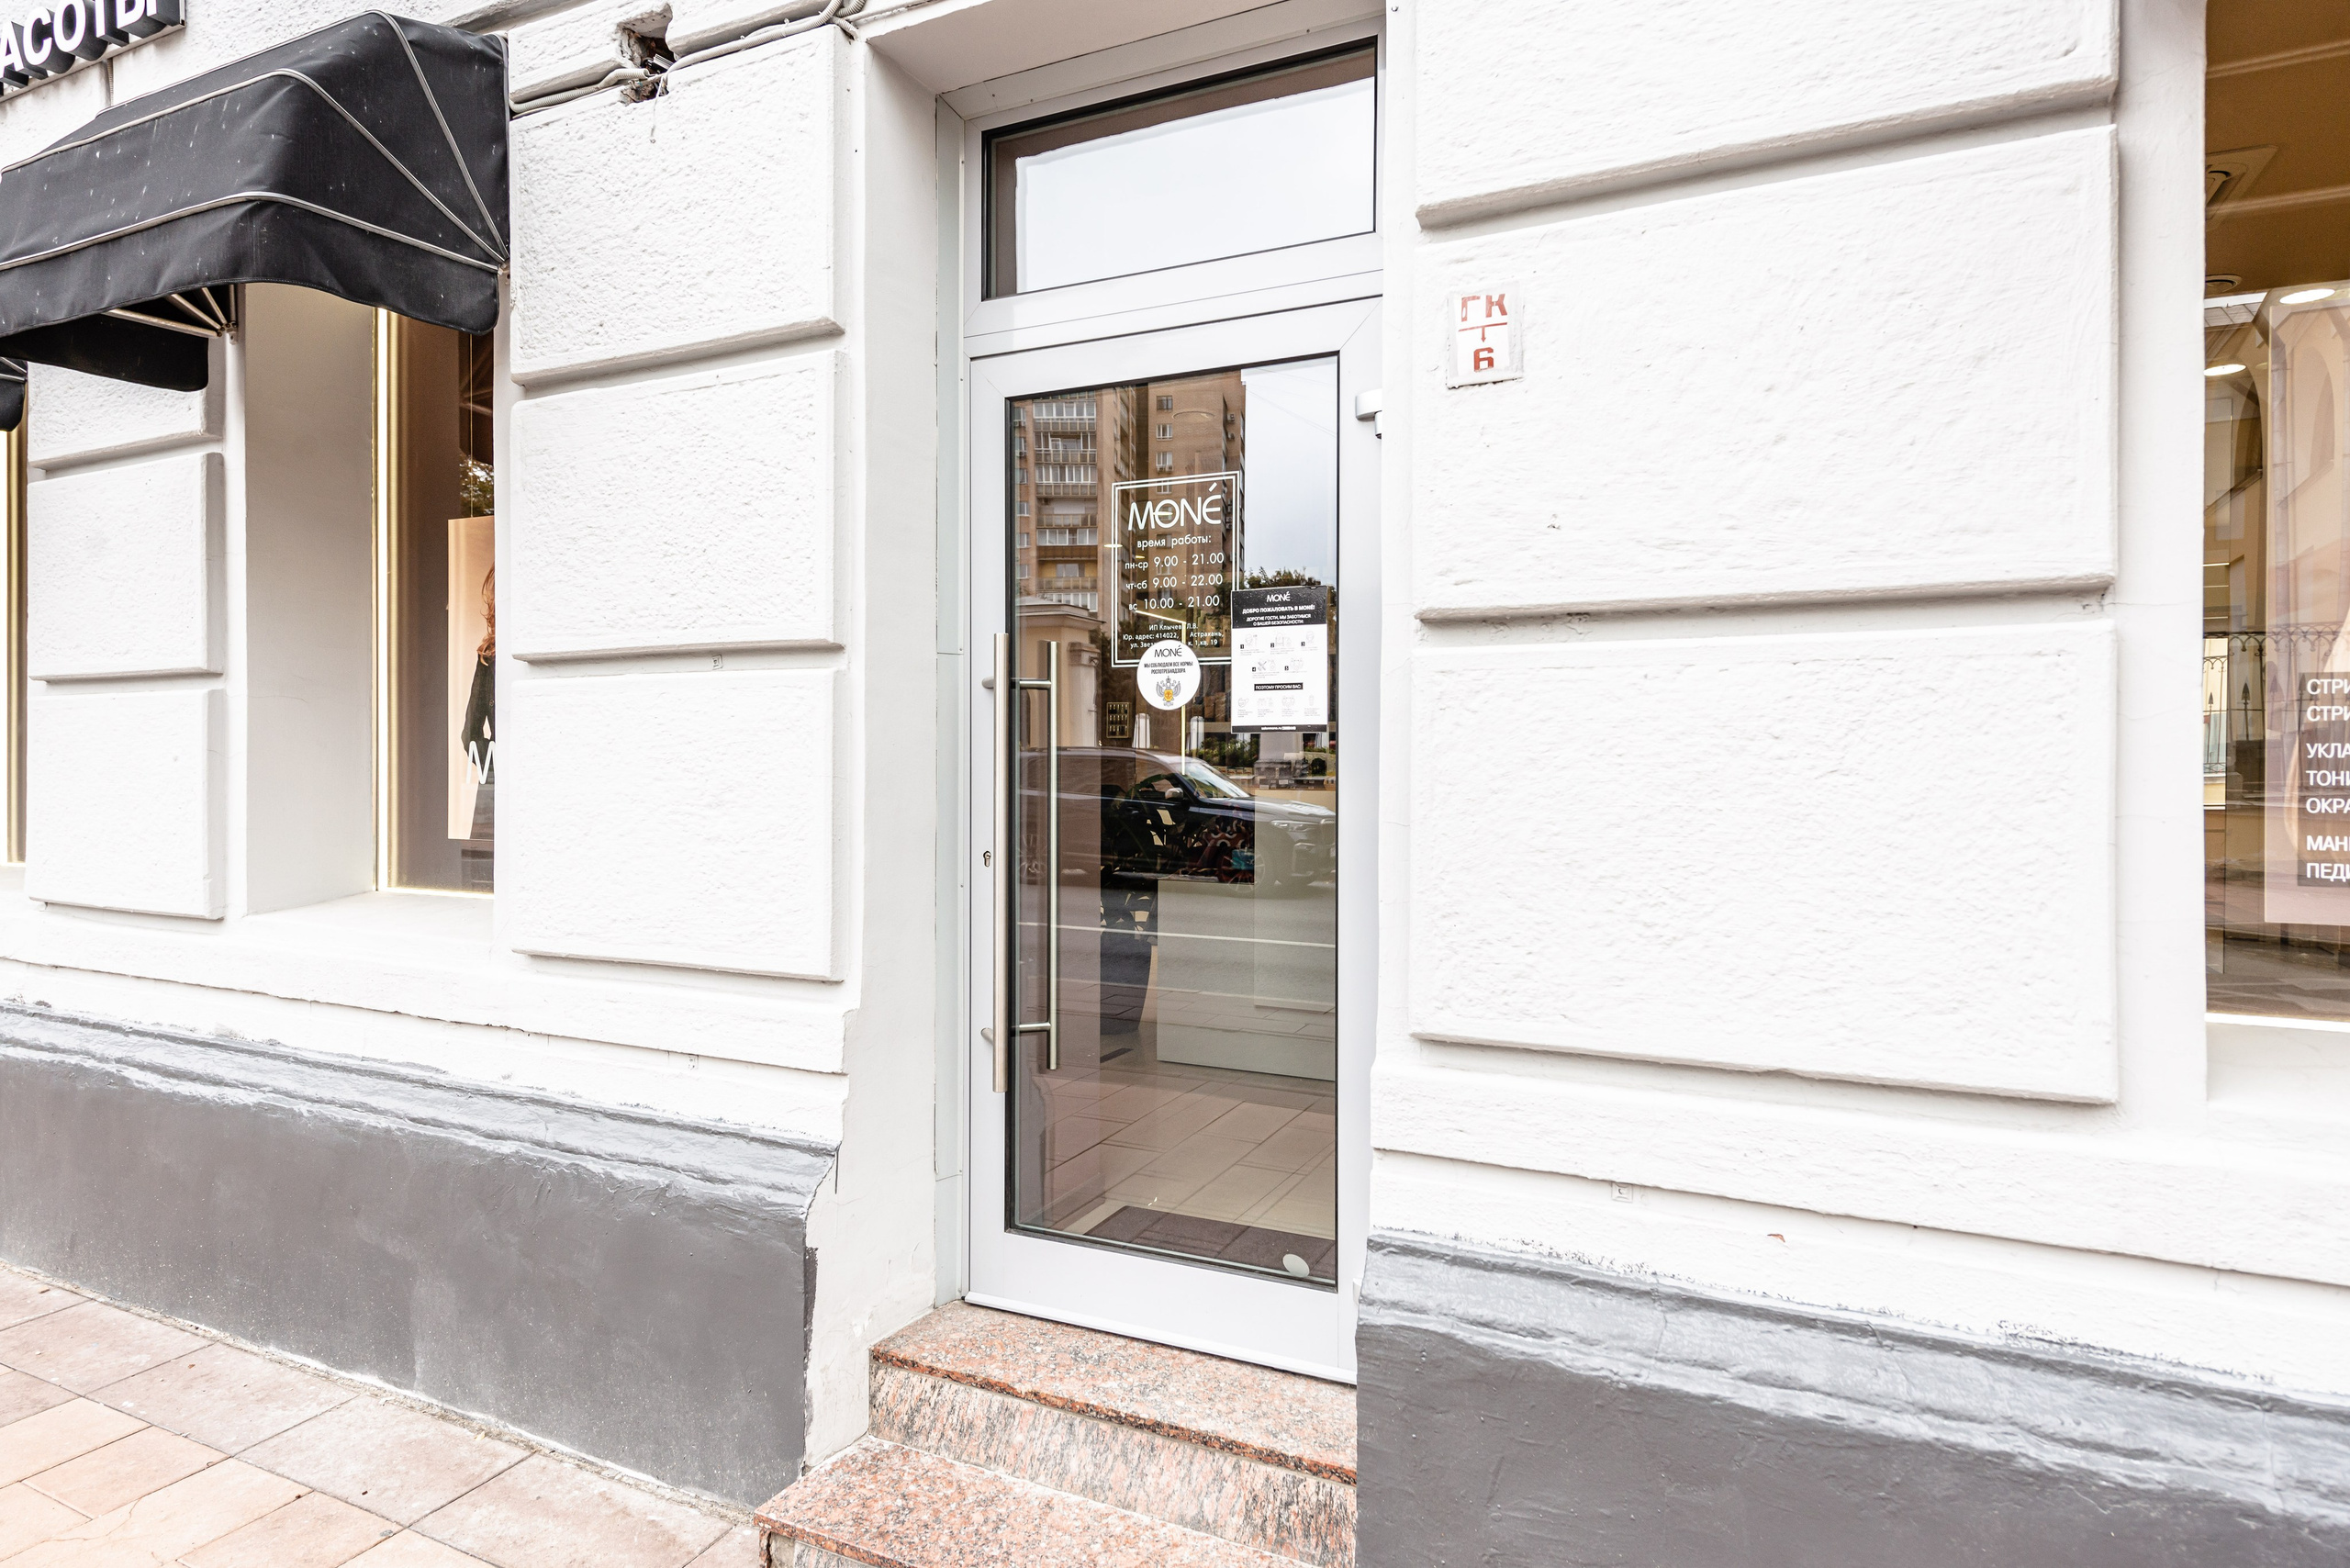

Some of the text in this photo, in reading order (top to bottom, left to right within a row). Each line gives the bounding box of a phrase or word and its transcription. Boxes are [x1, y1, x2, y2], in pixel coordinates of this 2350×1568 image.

[1460, 293, 1508, 322] ГК
[1473, 346, 1494, 373] 6
[1127, 482, 1222, 531] MONÉ
[1136, 533, 1212, 551] время работы:
[1125, 561, 1148, 571] пн-ср
[1153, 555, 1179, 567] 9.00
[1192, 552, 1225, 566] 21.00
[1125, 580, 1147, 590] чт-сб
[1152, 577, 1178, 588] 9.00
[1191, 574, 1223, 587] 22.00
[1144, 598, 1174, 610] 10.00
[1187, 595, 1220, 608] 21.00
[1267, 591, 1291, 602] MONÉ
[1154, 644, 1182, 657] MONÉ
[2306, 743, 2350, 758] УКЛА
[2306, 834, 2350, 851] МАН
